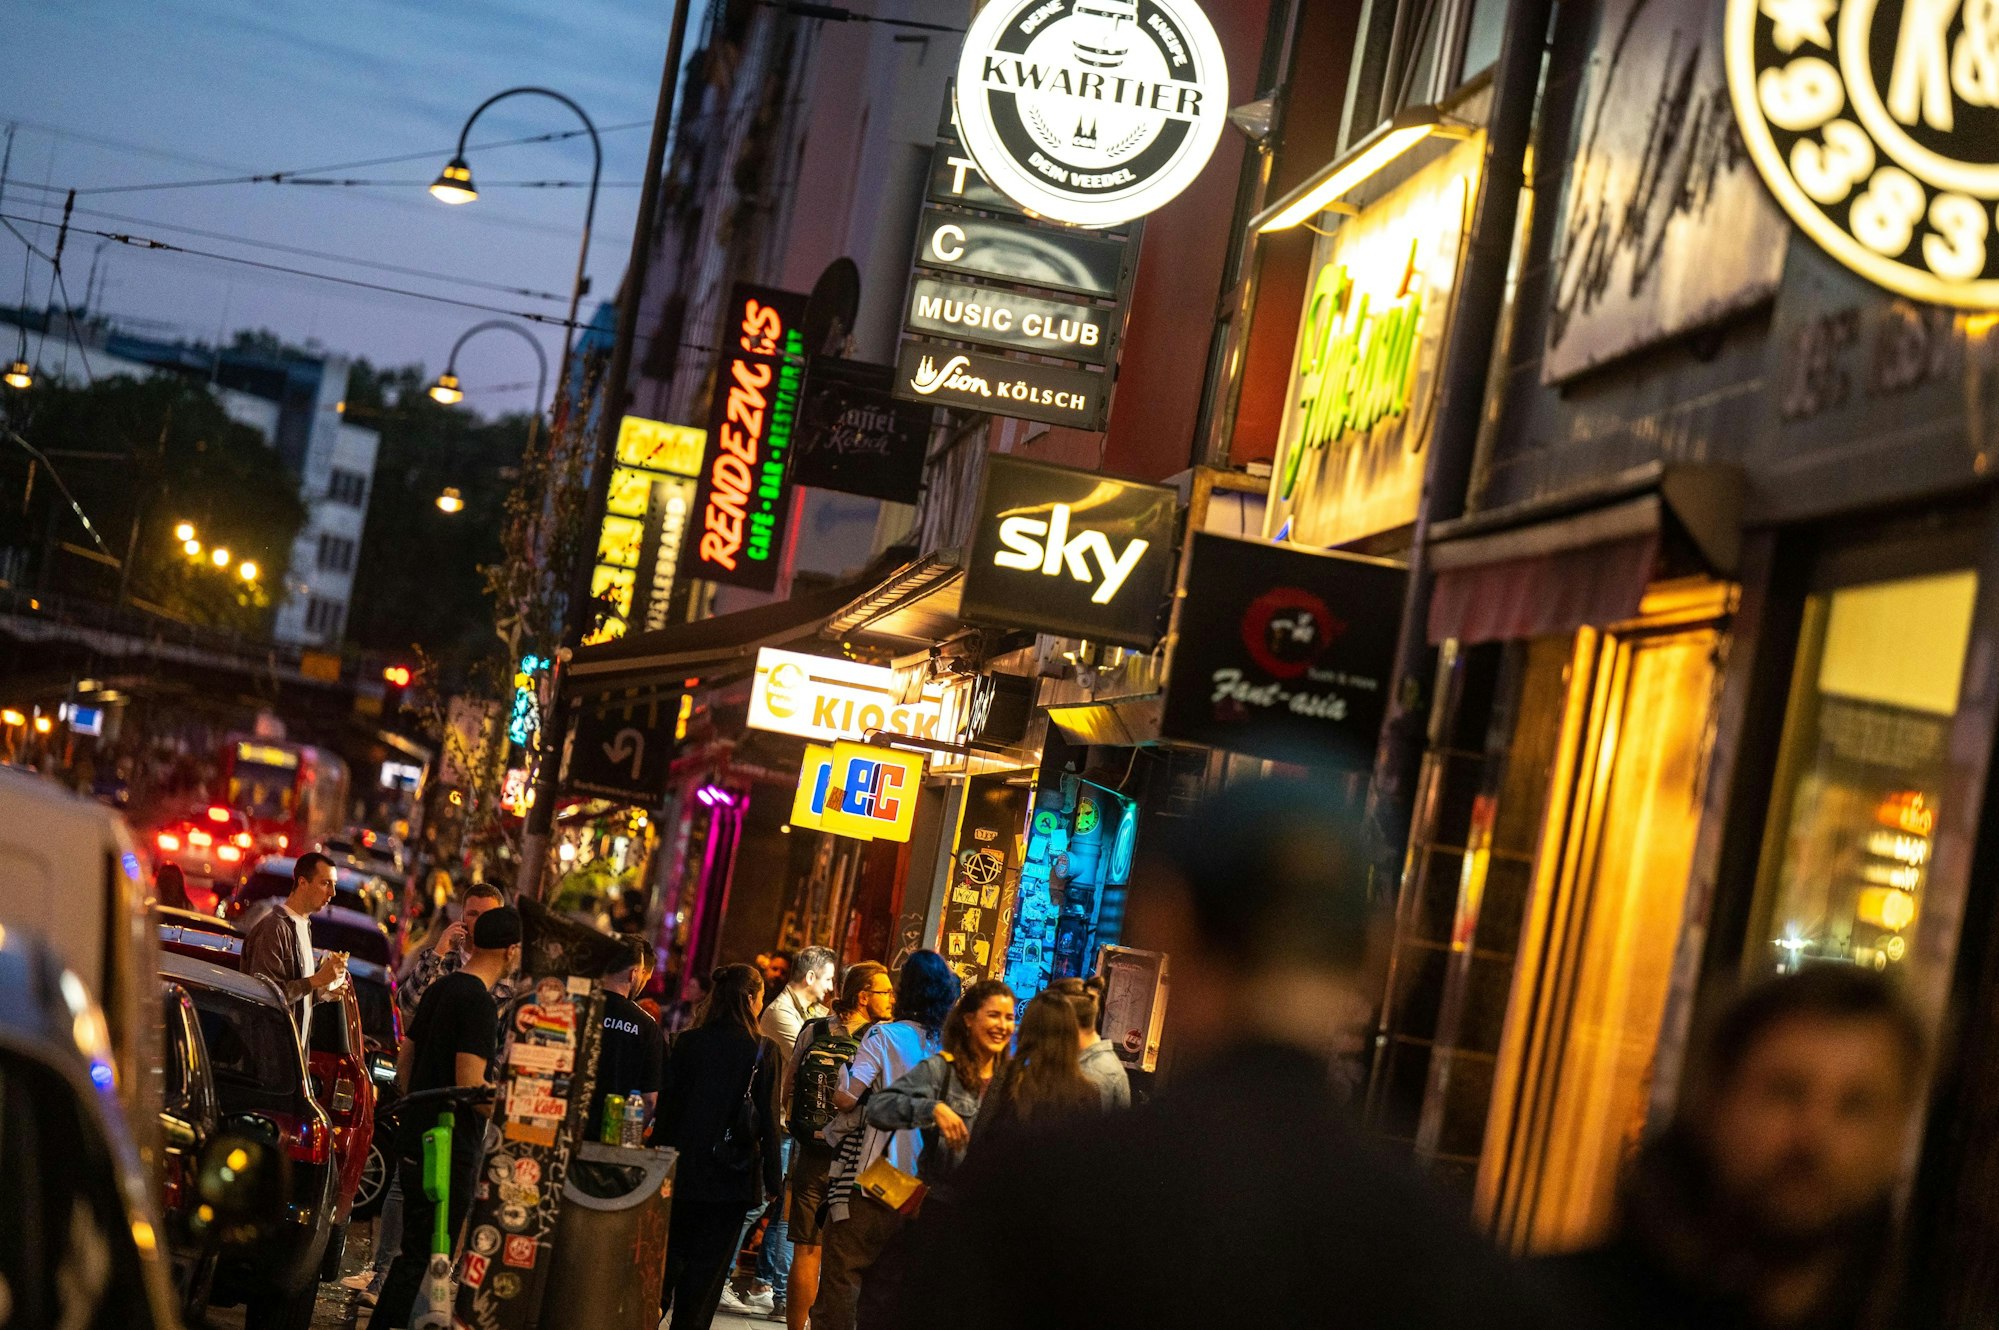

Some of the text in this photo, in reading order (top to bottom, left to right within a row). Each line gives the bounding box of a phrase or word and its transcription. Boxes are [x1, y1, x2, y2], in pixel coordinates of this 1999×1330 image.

[1019, 0, 1065, 35] DEINE
[1148, 13, 1188, 68] KNEIPE
[981, 55, 1204, 118] KWARTIER
[947, 156, 976, 195] T
[1028, 152, 1136, 189] DEIN VEEDEL
[1757, 56, 1999, 284] 9383
[931, 225, 966, 262] C
[917, 295, 1100, 347] MUSIC CLUB
[997, 380, 1086, 411] KÖLSCH
[758, 461, 785, 500] BAR
[747, 512, 775, 560] CAFÉ
[993, 503, 1150, 605] sky
[812, 695, 939, 740] KIOSK
[603, 1017, 639, 1035] CIAGA
